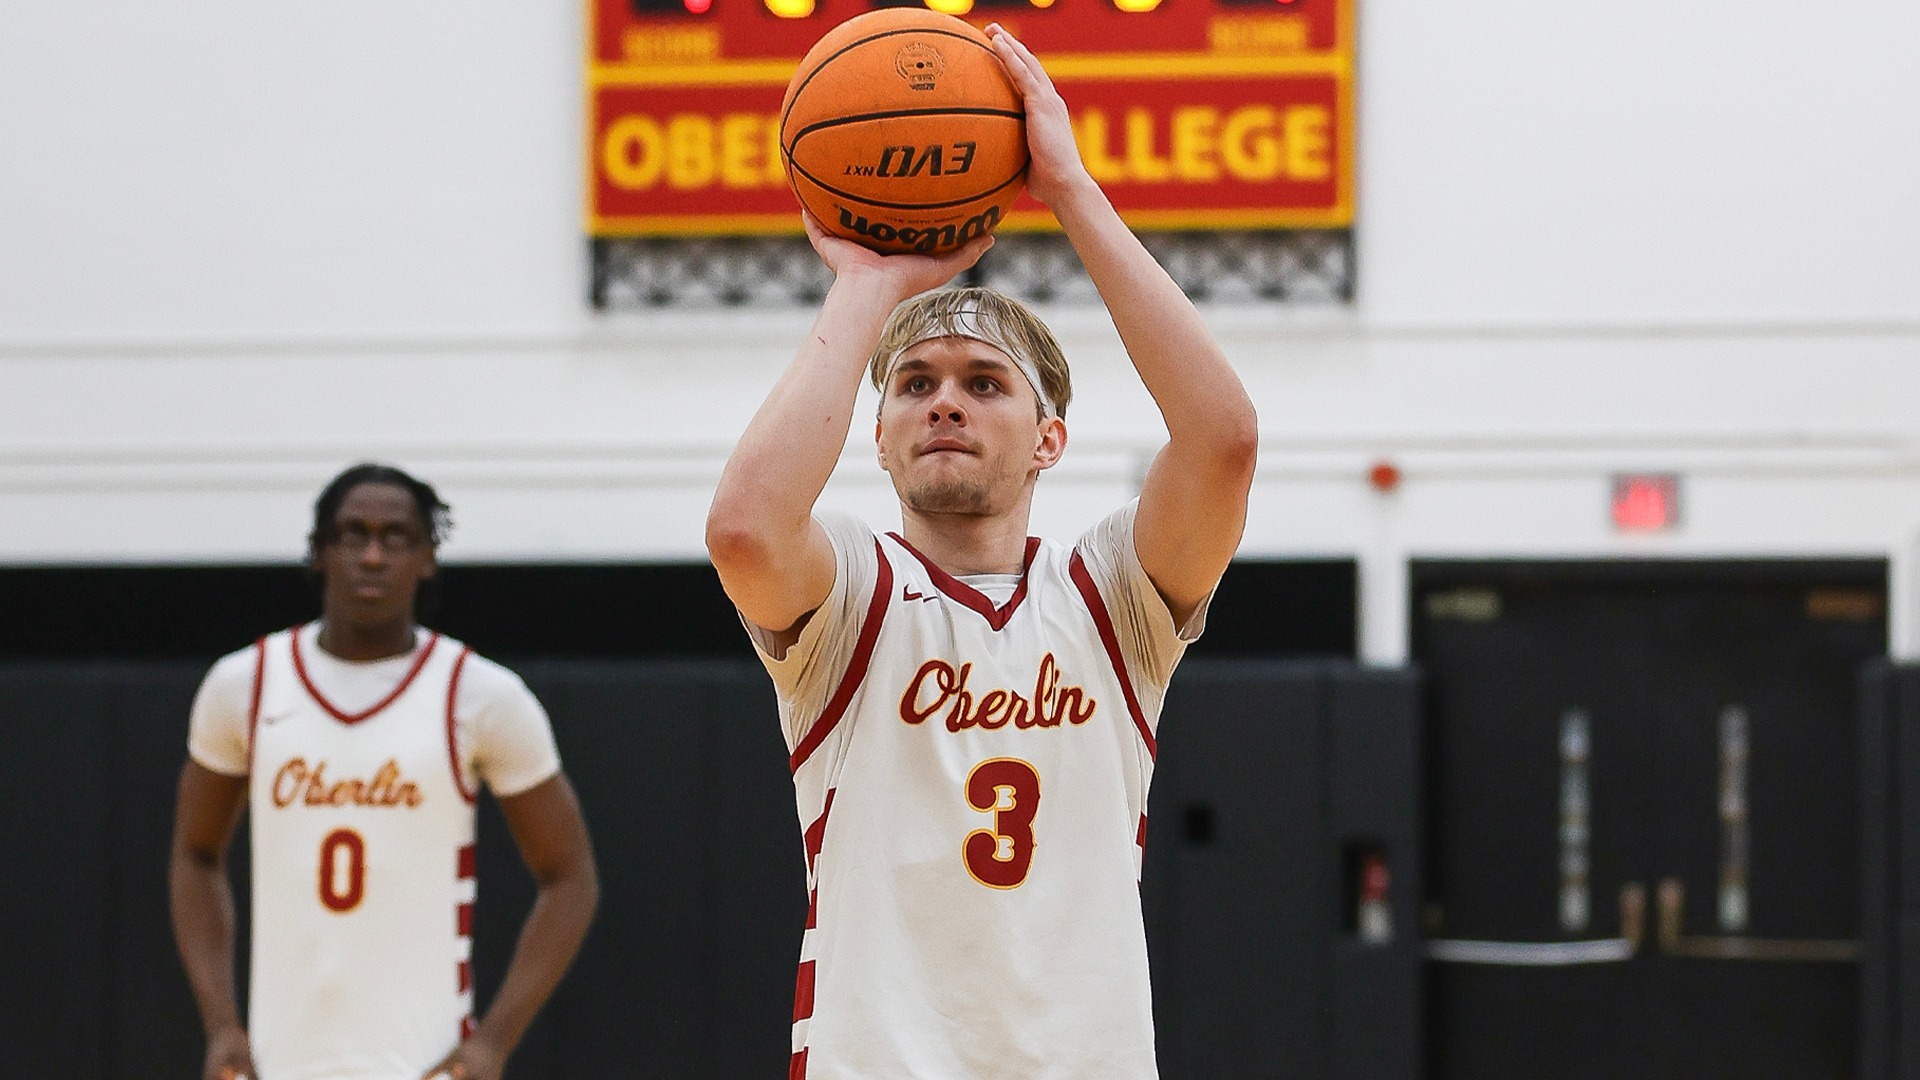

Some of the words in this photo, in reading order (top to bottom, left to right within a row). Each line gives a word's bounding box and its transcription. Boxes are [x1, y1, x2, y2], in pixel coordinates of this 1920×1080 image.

[844, 165, 875, 176] NXT
[876, 141, 976, 177] EVO
[1072, 105, 1330, 183] LLEGE
[839, 204, 1000, 250] Wilson
[899, 651, 1096, 733] Oberlin
[271, 756, 424, 810] Oberlin
[962, 757, 1041, 890] 3
[317, 826, 366, 915] 0
